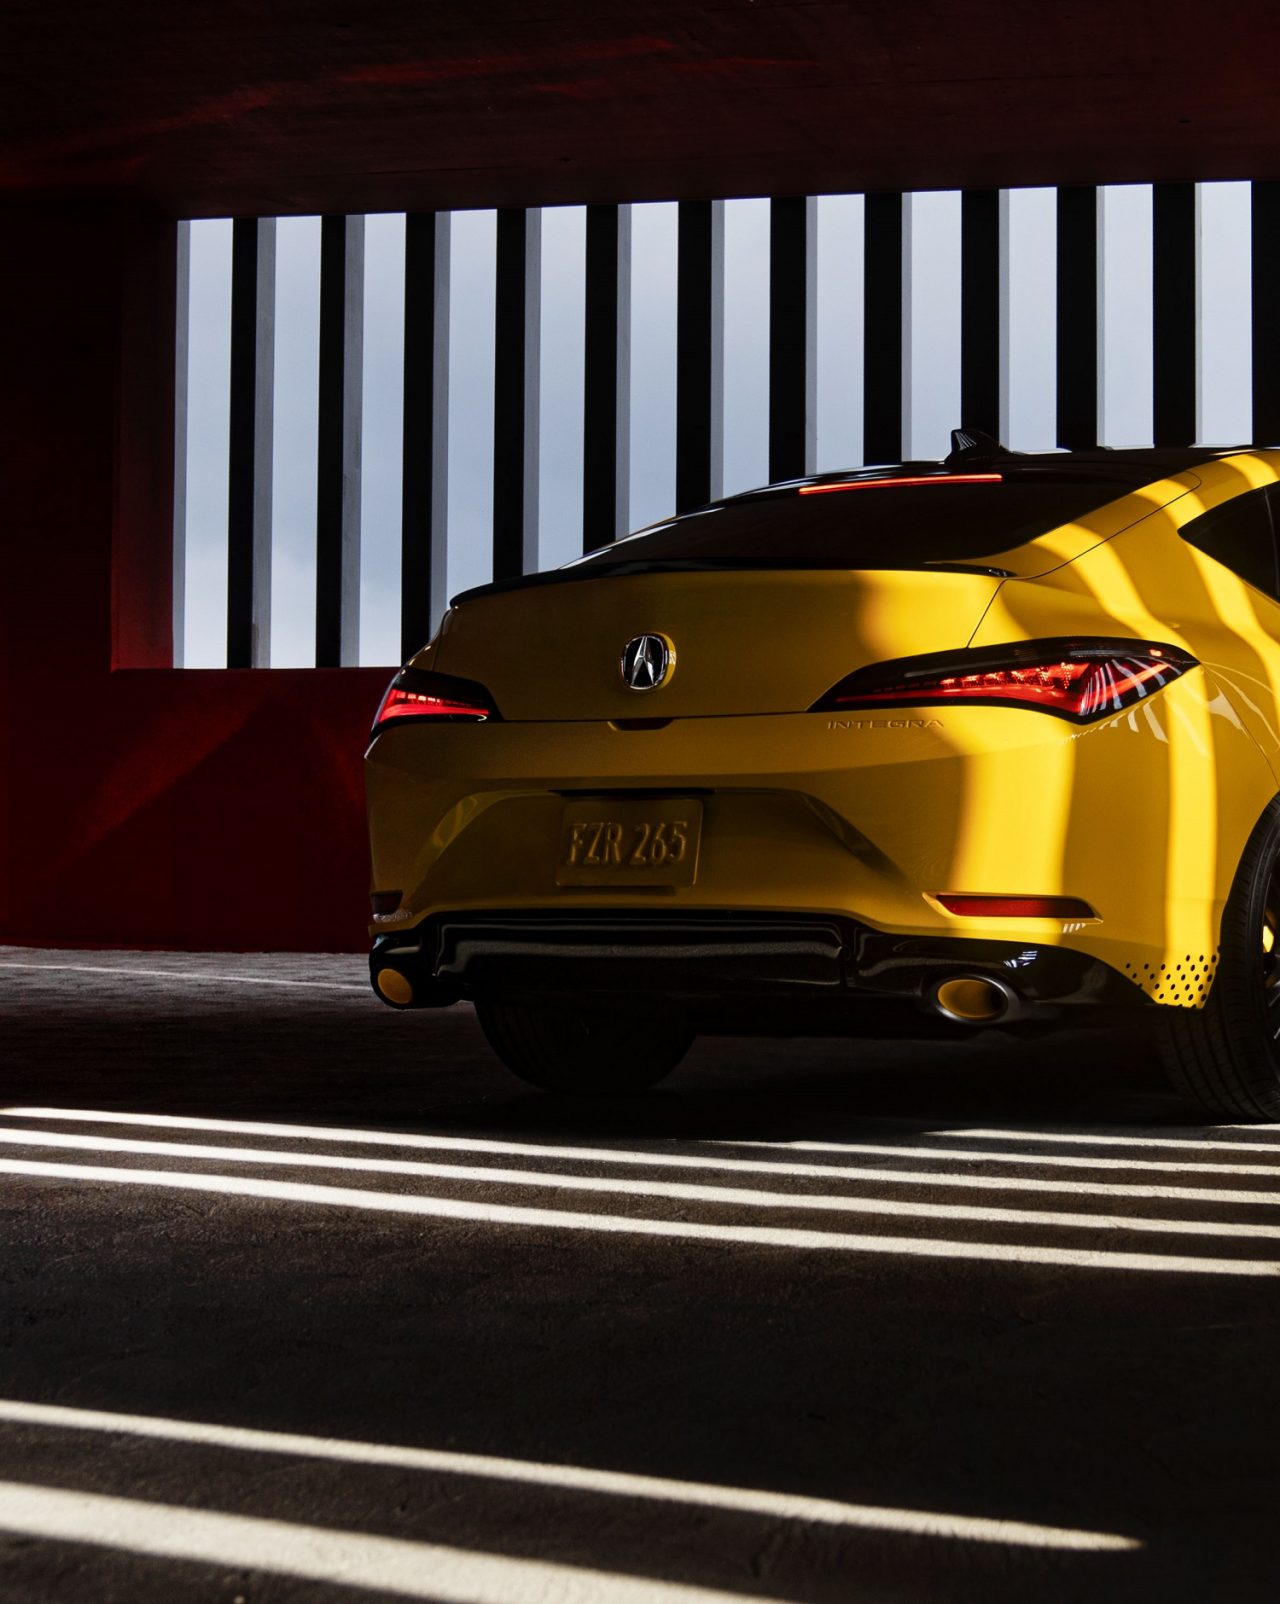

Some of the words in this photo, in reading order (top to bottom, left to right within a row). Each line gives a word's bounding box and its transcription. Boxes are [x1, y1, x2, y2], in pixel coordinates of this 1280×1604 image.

[826, 718, 945, 730] INTEGRA
[567, 821, 622, 863] FZR
[629, 820, 687, 863] 265
